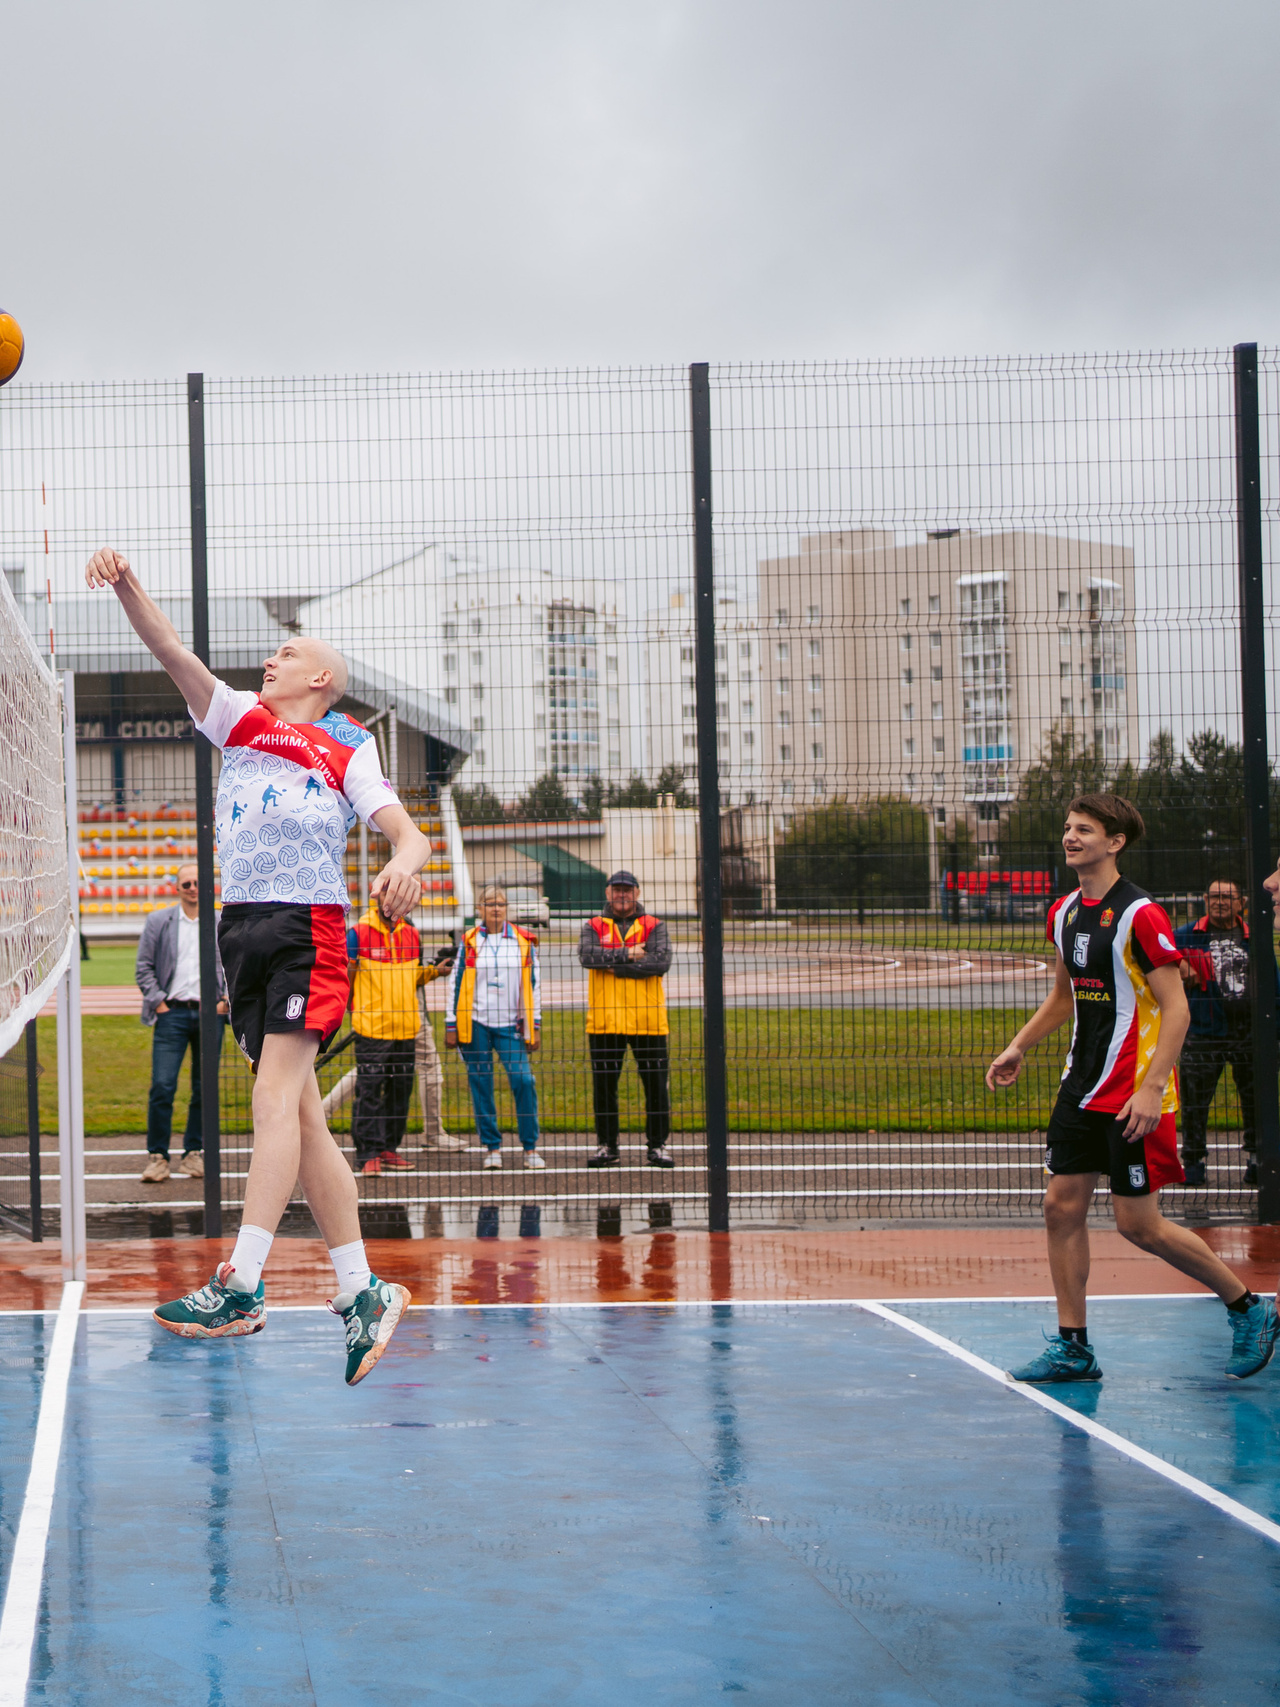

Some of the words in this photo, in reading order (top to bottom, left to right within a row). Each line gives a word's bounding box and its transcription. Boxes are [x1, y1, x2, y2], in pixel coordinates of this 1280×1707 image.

[1073, 933, 1091, 967] 5
[285, 993, 305, 1020] 8
[1128, 1164, 1145, 1187] 5
